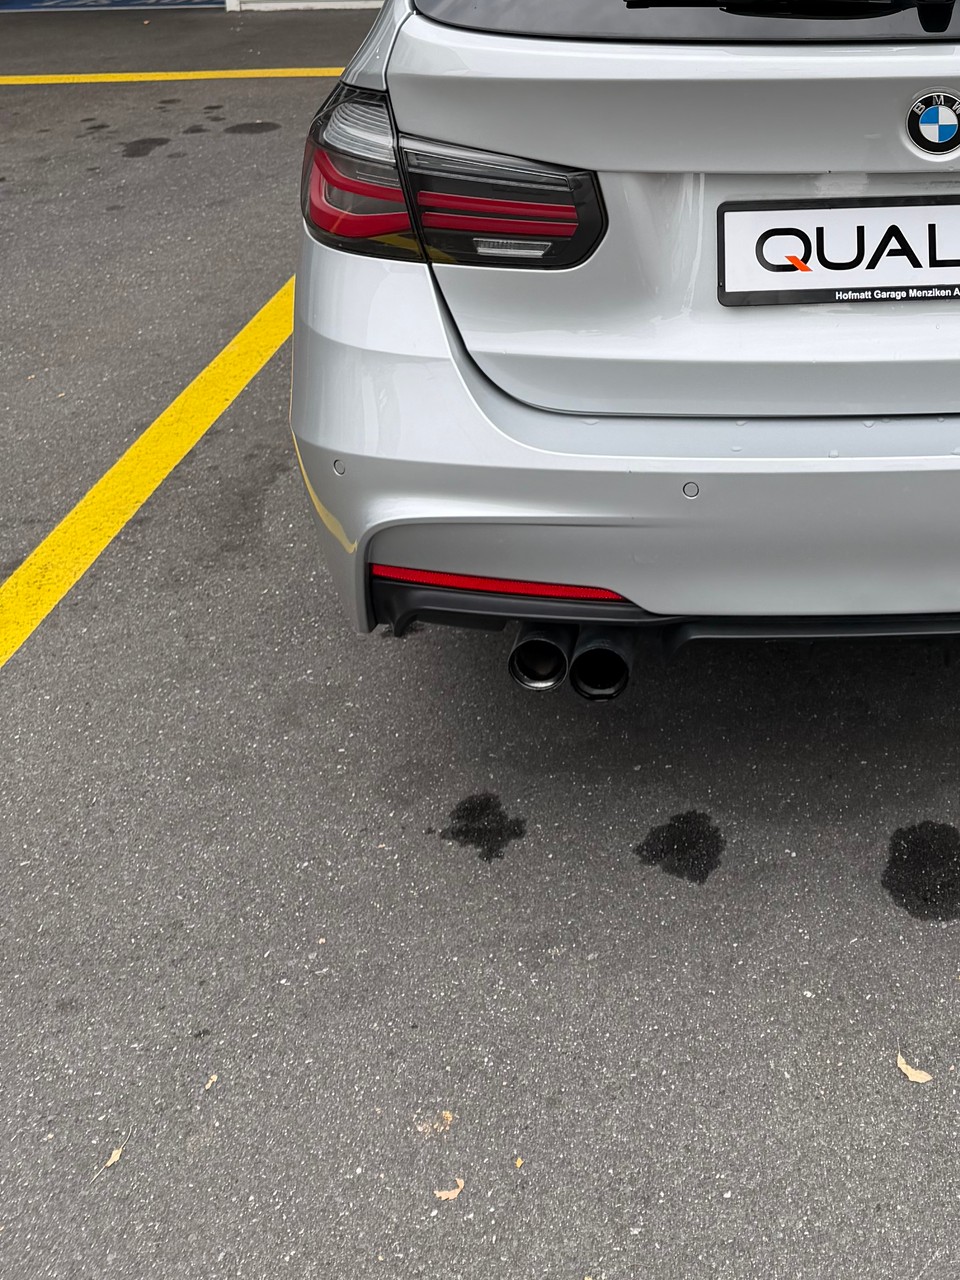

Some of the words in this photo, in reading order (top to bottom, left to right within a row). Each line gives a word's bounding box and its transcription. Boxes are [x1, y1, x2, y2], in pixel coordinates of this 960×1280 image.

[835, 290, 872, 300] Hofmatt
[873, 289, 907, 300] Garage
[908, 288, 952, 298] Menziken
